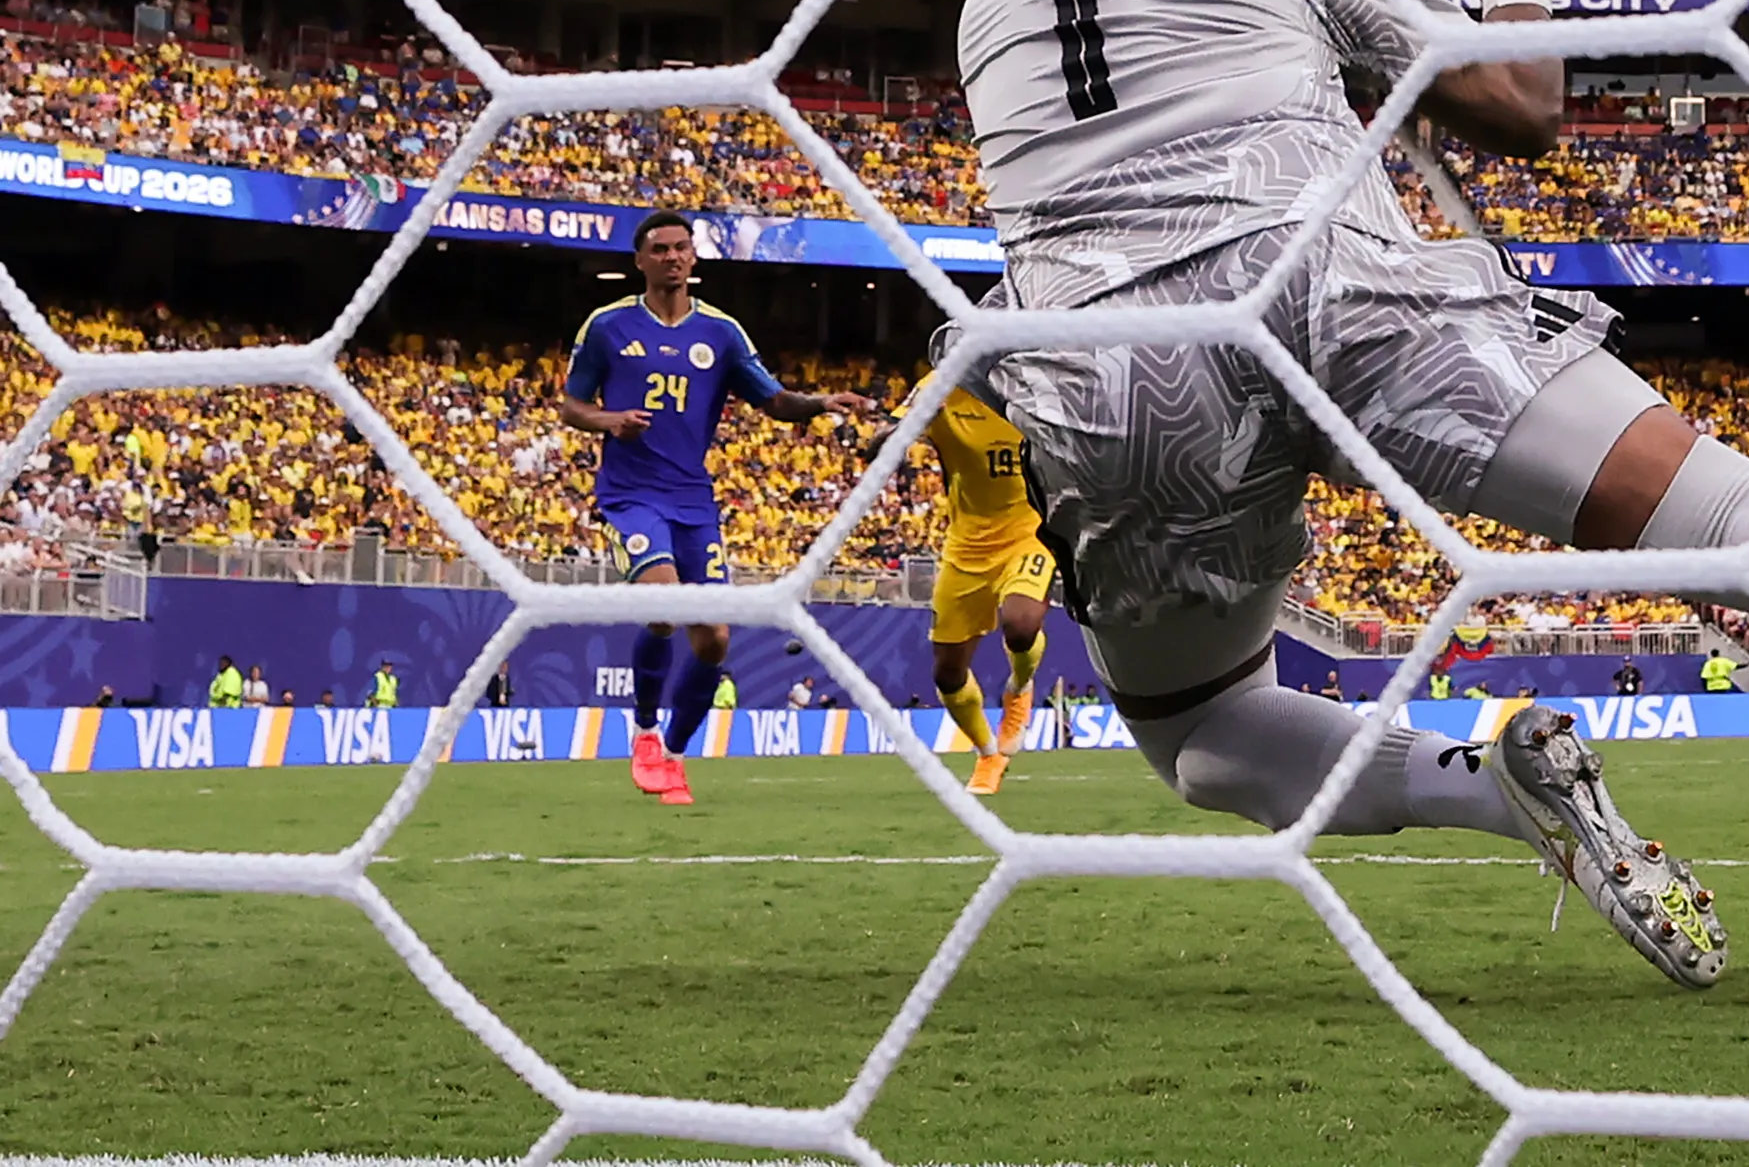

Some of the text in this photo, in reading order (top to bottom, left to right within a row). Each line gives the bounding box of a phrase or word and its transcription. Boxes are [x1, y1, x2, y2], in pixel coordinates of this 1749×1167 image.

[0, 149, 86, 189] WORL
[141, 169, 233, 207] 2026
[549, 210, 615, 241] CITY
[644, 373, 688, 413] 24
[1018, 553, 1046, 576] 19
[129, 708, 215, 768] VISA
[317, 708, 391, 764] VISA
[479, 709, 543, 761] VISA
[748, 710, 800, 756] VISA
[1572, 696, 1699, 740] VISA
